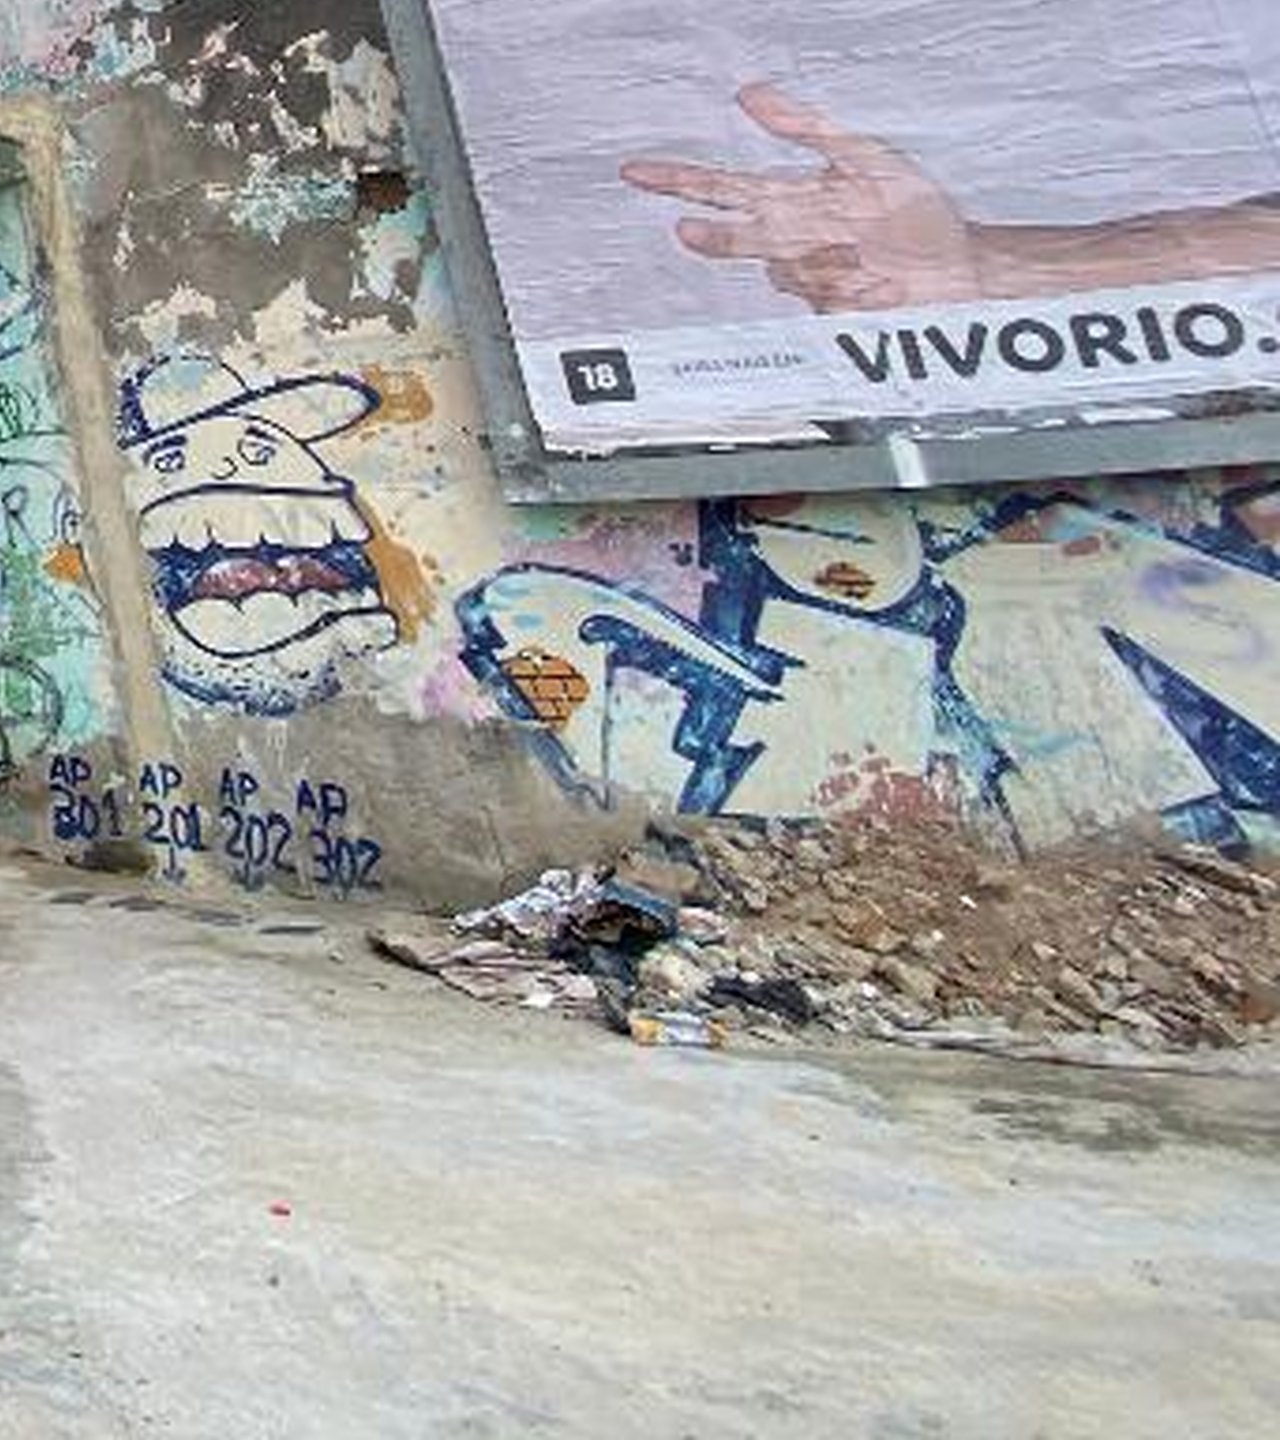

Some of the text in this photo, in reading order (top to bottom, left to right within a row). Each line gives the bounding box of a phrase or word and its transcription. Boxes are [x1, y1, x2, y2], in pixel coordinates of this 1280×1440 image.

[834, 302, 1280, 384] VIVORIO.
[577, 362, 619, 391] 18
[49, 754, 92, 787] AP
[140, 763, 182, 799] AP
[220, 766, 259, 807] AP
[296, 779, 347, 827] AP
